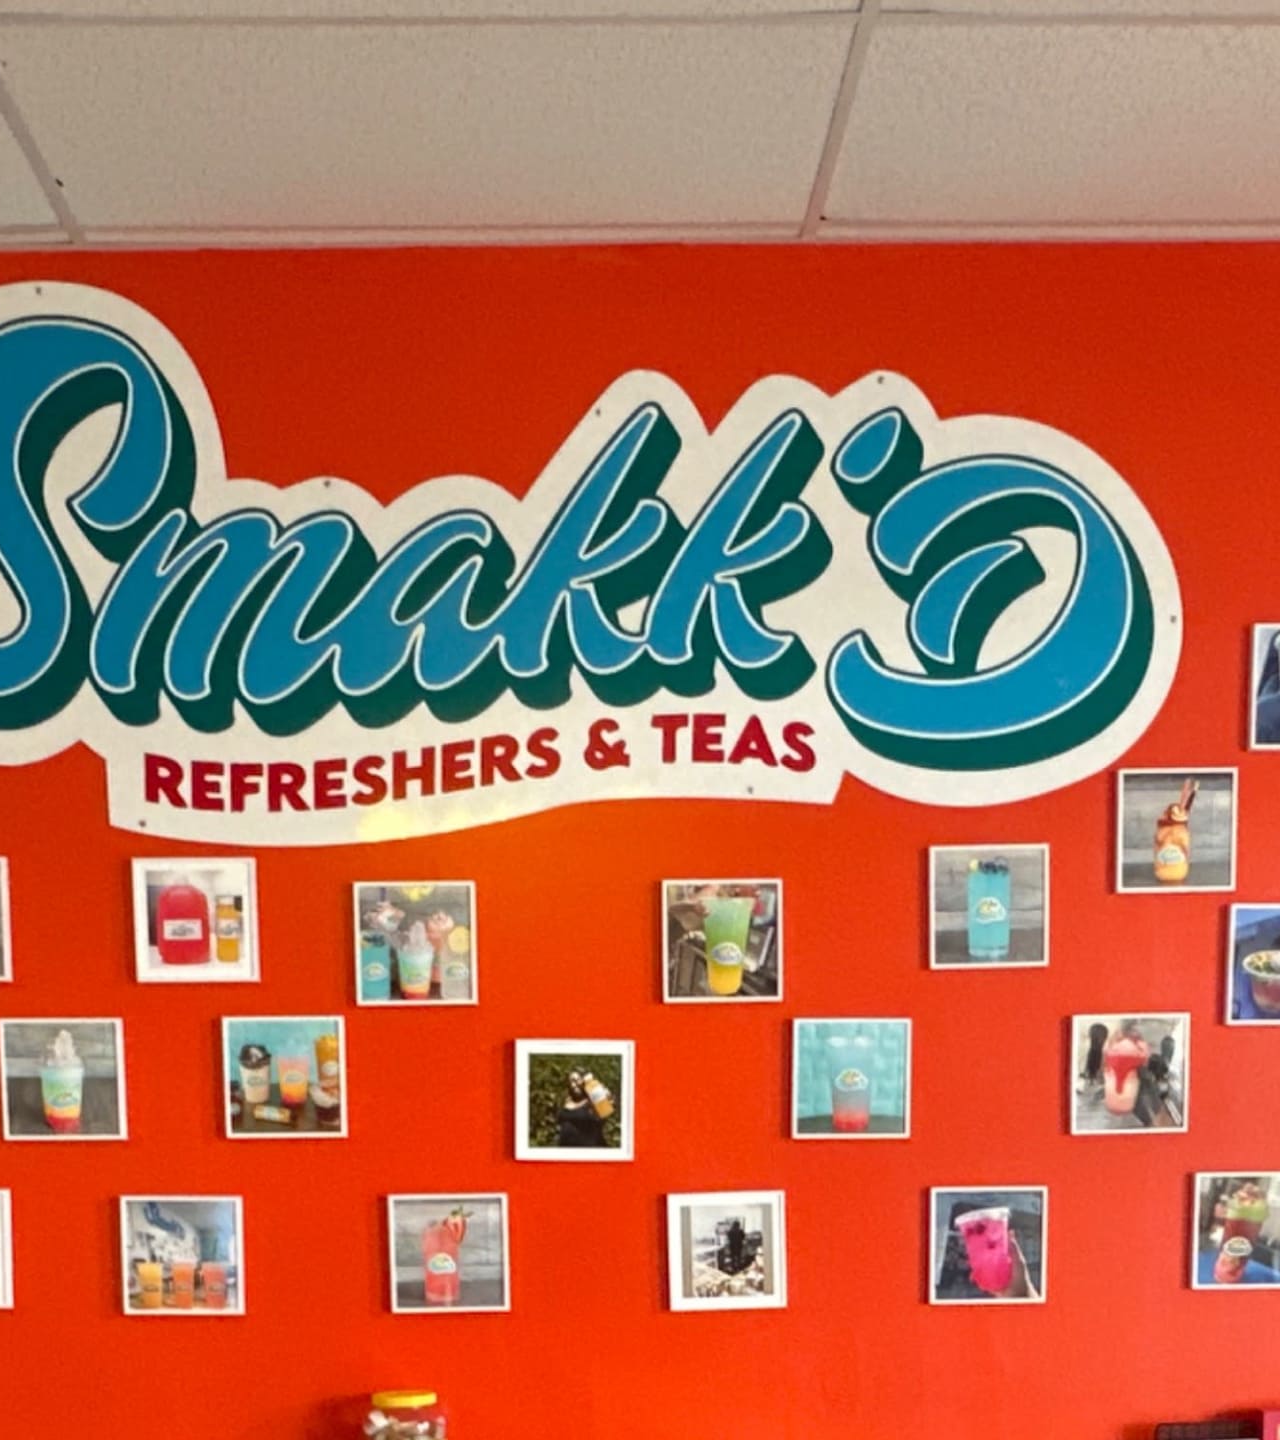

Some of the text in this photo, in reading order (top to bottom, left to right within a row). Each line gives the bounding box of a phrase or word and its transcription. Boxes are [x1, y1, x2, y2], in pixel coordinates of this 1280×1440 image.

[143, 713, 817, 812] REFRESHERS & TEAS
